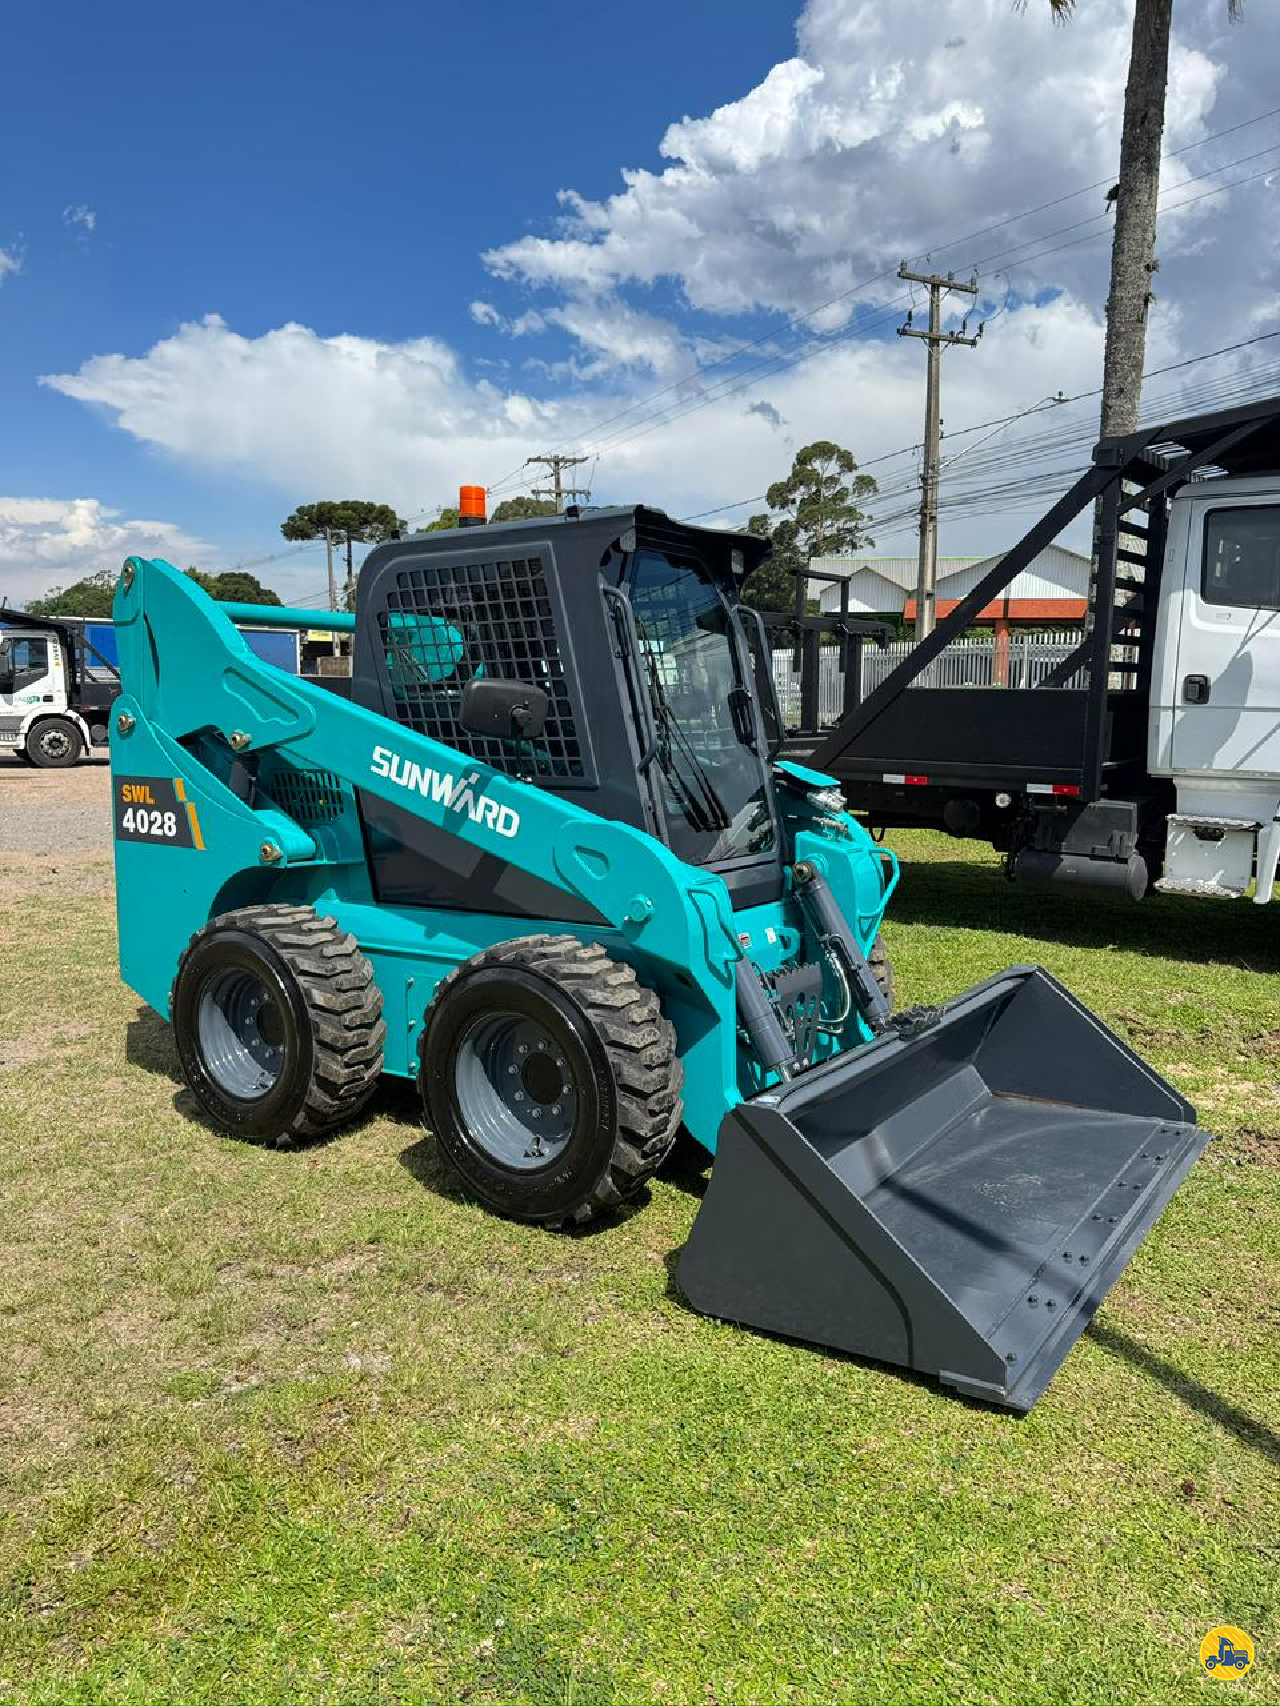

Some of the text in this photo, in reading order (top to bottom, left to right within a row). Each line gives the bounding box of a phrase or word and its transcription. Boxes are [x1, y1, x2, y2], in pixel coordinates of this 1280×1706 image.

[122, 784, 156, 805] SWL
[370, 745, 520, 838] SUNWARD
[122, 807, 177, 837] 4028
